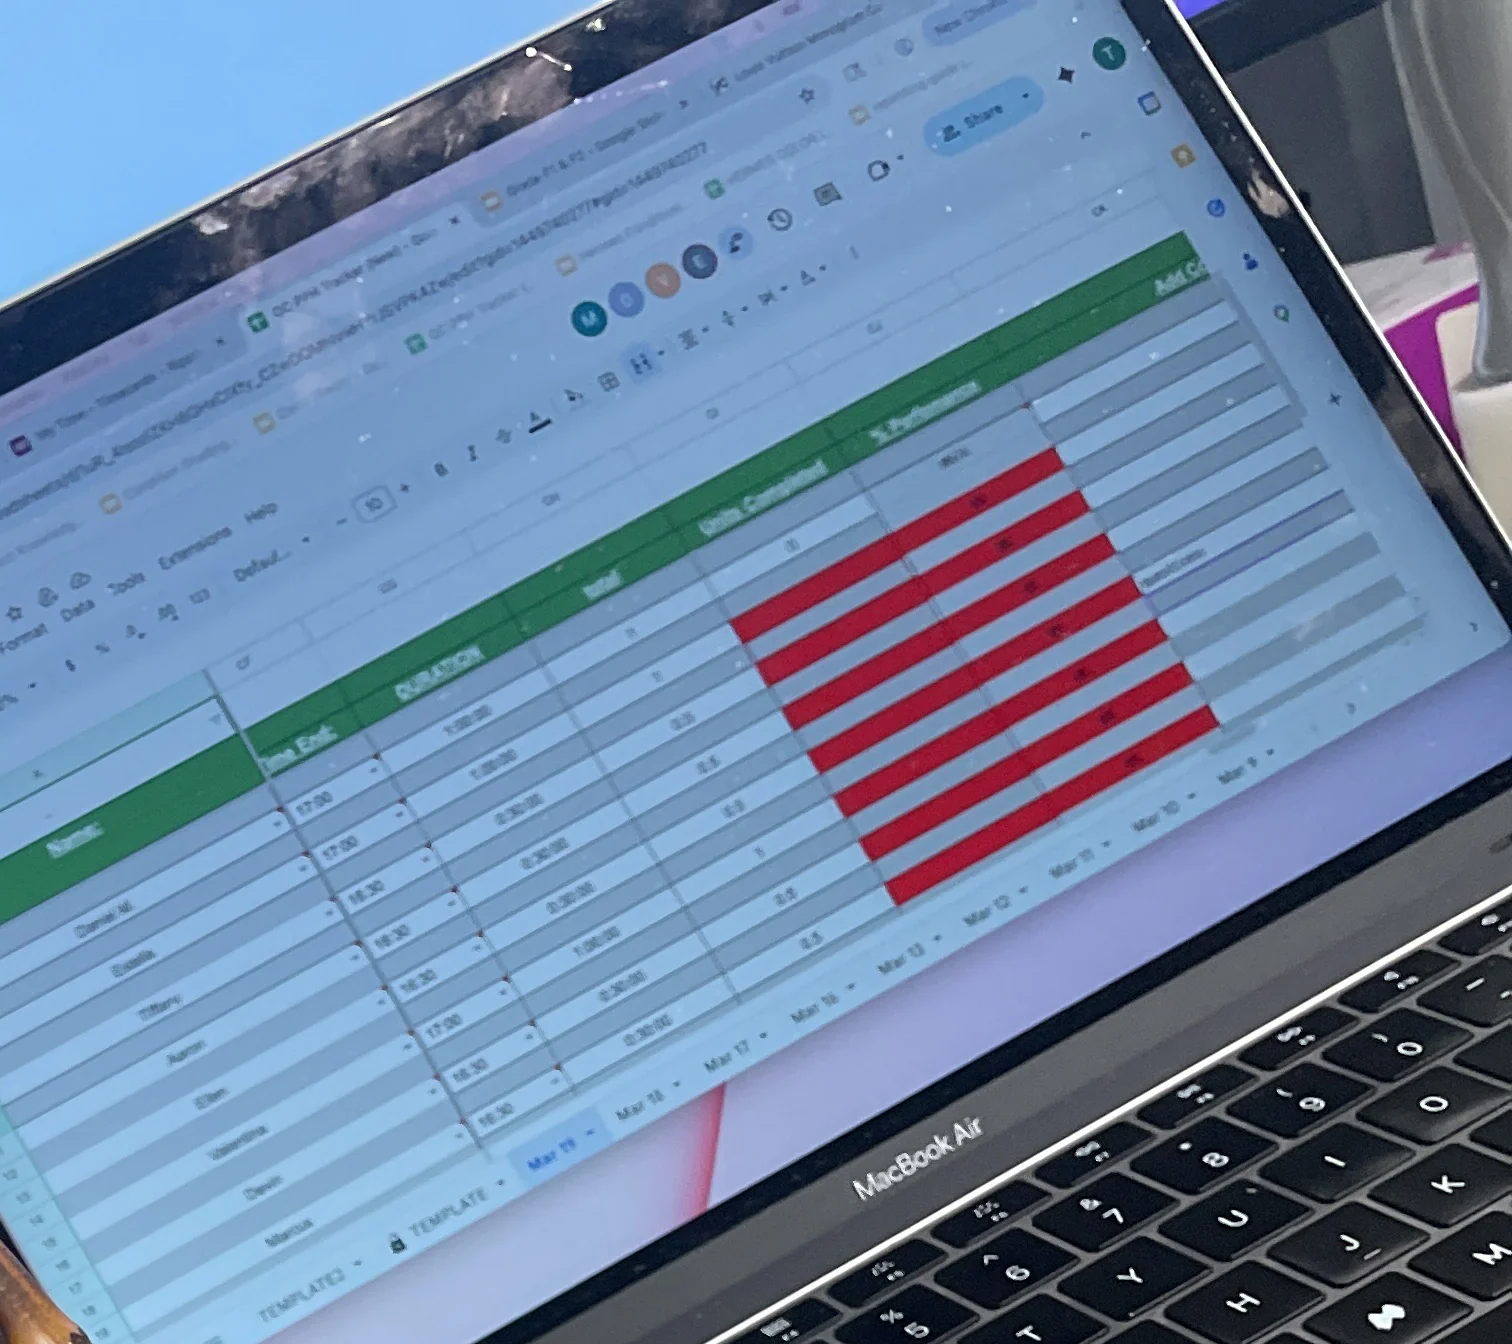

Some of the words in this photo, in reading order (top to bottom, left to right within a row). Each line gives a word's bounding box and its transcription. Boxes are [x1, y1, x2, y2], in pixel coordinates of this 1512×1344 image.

[1299, 1096, 1327, 1112] 9
[851, 1134, 957, 1200] MacBook
[952, 1116, 985, 1146] Air
[1202, 1151, 1230, 1169] 8
[1430, 1173, 1467, 1195] K
[409, 1185, 490, 1239] TEMPLATE
[1217, 1209, 1249, 1230] U
[1473, 1241, 1512, 1267] M
[1005, 1264, 1031, 1282] 6
[1117, 1268, 1145, 1286] Y
[1225, 1291, 1262, 1315] H
[904, 1322, 932, 1341] 5
[1016, 1325, 1043, 1344] T
